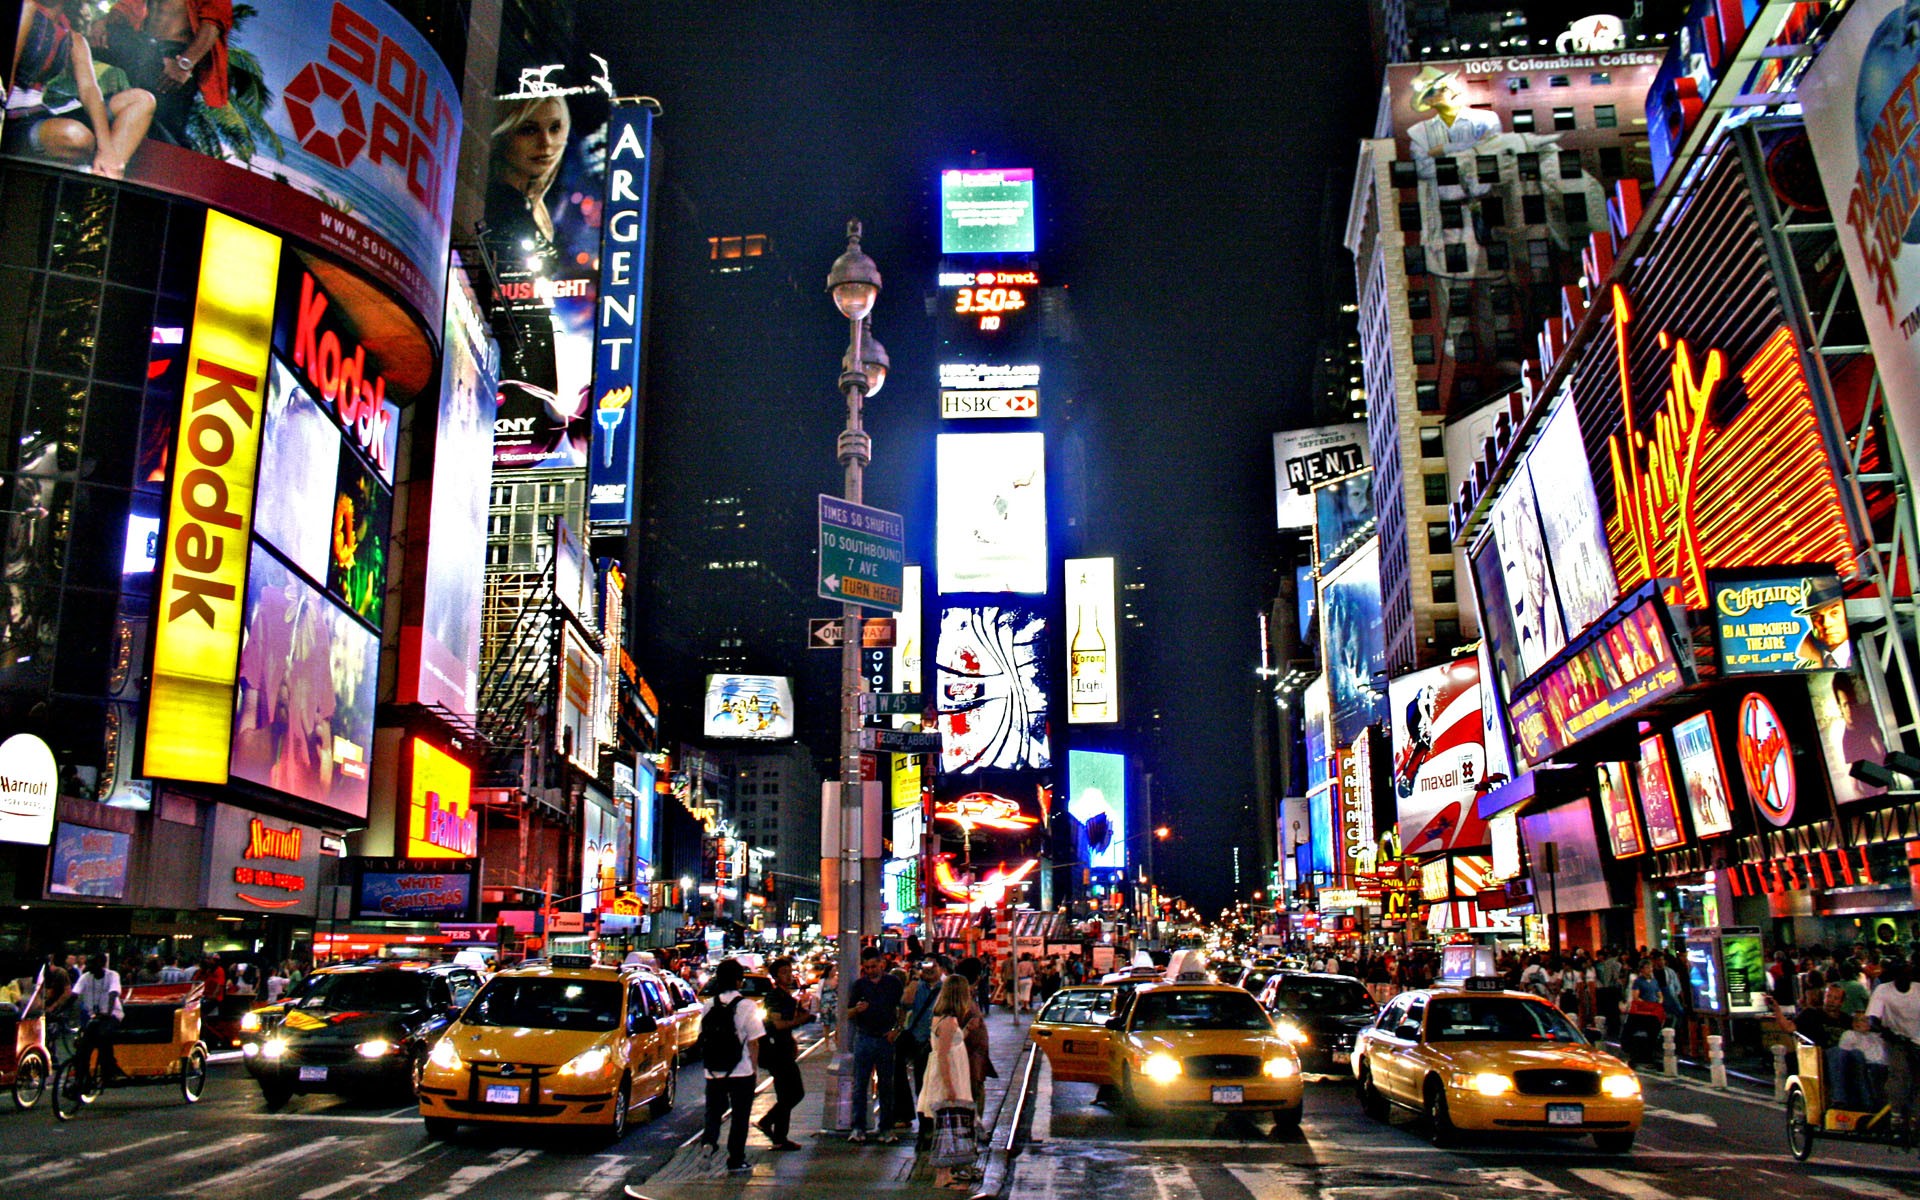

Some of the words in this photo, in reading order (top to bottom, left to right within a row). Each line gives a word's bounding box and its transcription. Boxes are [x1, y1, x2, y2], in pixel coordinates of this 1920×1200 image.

[1465, 61, 1503, 73] 100%
[1507, 56, 1595, 71] Colombian
[1599, 52, 1655, 66] Coffee
[602, 123, 645, 371] ARGENT
[955, 288, 1007, 312] 3.50
[294, 270, 391, 472] Kodak
[945, 396, 1001, 412] HSBC
[493, 417, 536, 432] KNY
[1288, 449, 1356, 483] RENT
[168, 358, 258, 630] Kodak
[823, 505, 848, 523] TIMES
[851, 511, 863, 527] SQ
[865, 515, 900, 537] SHUFFLE
[823, 531, 836, 548] TO
[839, 536, 901, 563] SOUTHBOUND
[848, 557, 854, 571] 7
[859, 563, 879, 577] AVE
[843, 578, 870, 598] TURN
[873, 584, 900, 604] HERE
[1748, 621, 1801, 636] HIRSCHFELD
[1745, 636, 1787, 650] THEATRE
[879, 694, 889, 711] W
[892, 696, 908, 712] 45
[877, 730, 906, 745] GEORGE
[907, 733, 941, 746] ABBOTT
[1421, 769, 1459, 792] maxell
[1343, 757, 1359, 858] PALACE
[244, 818, 302, 861] Marriott
[364, 860, 473, 871] MARQUIS
[397, 875, 445, 890] WHITE
[381, 889, 464, 913] CHRISTMAS
